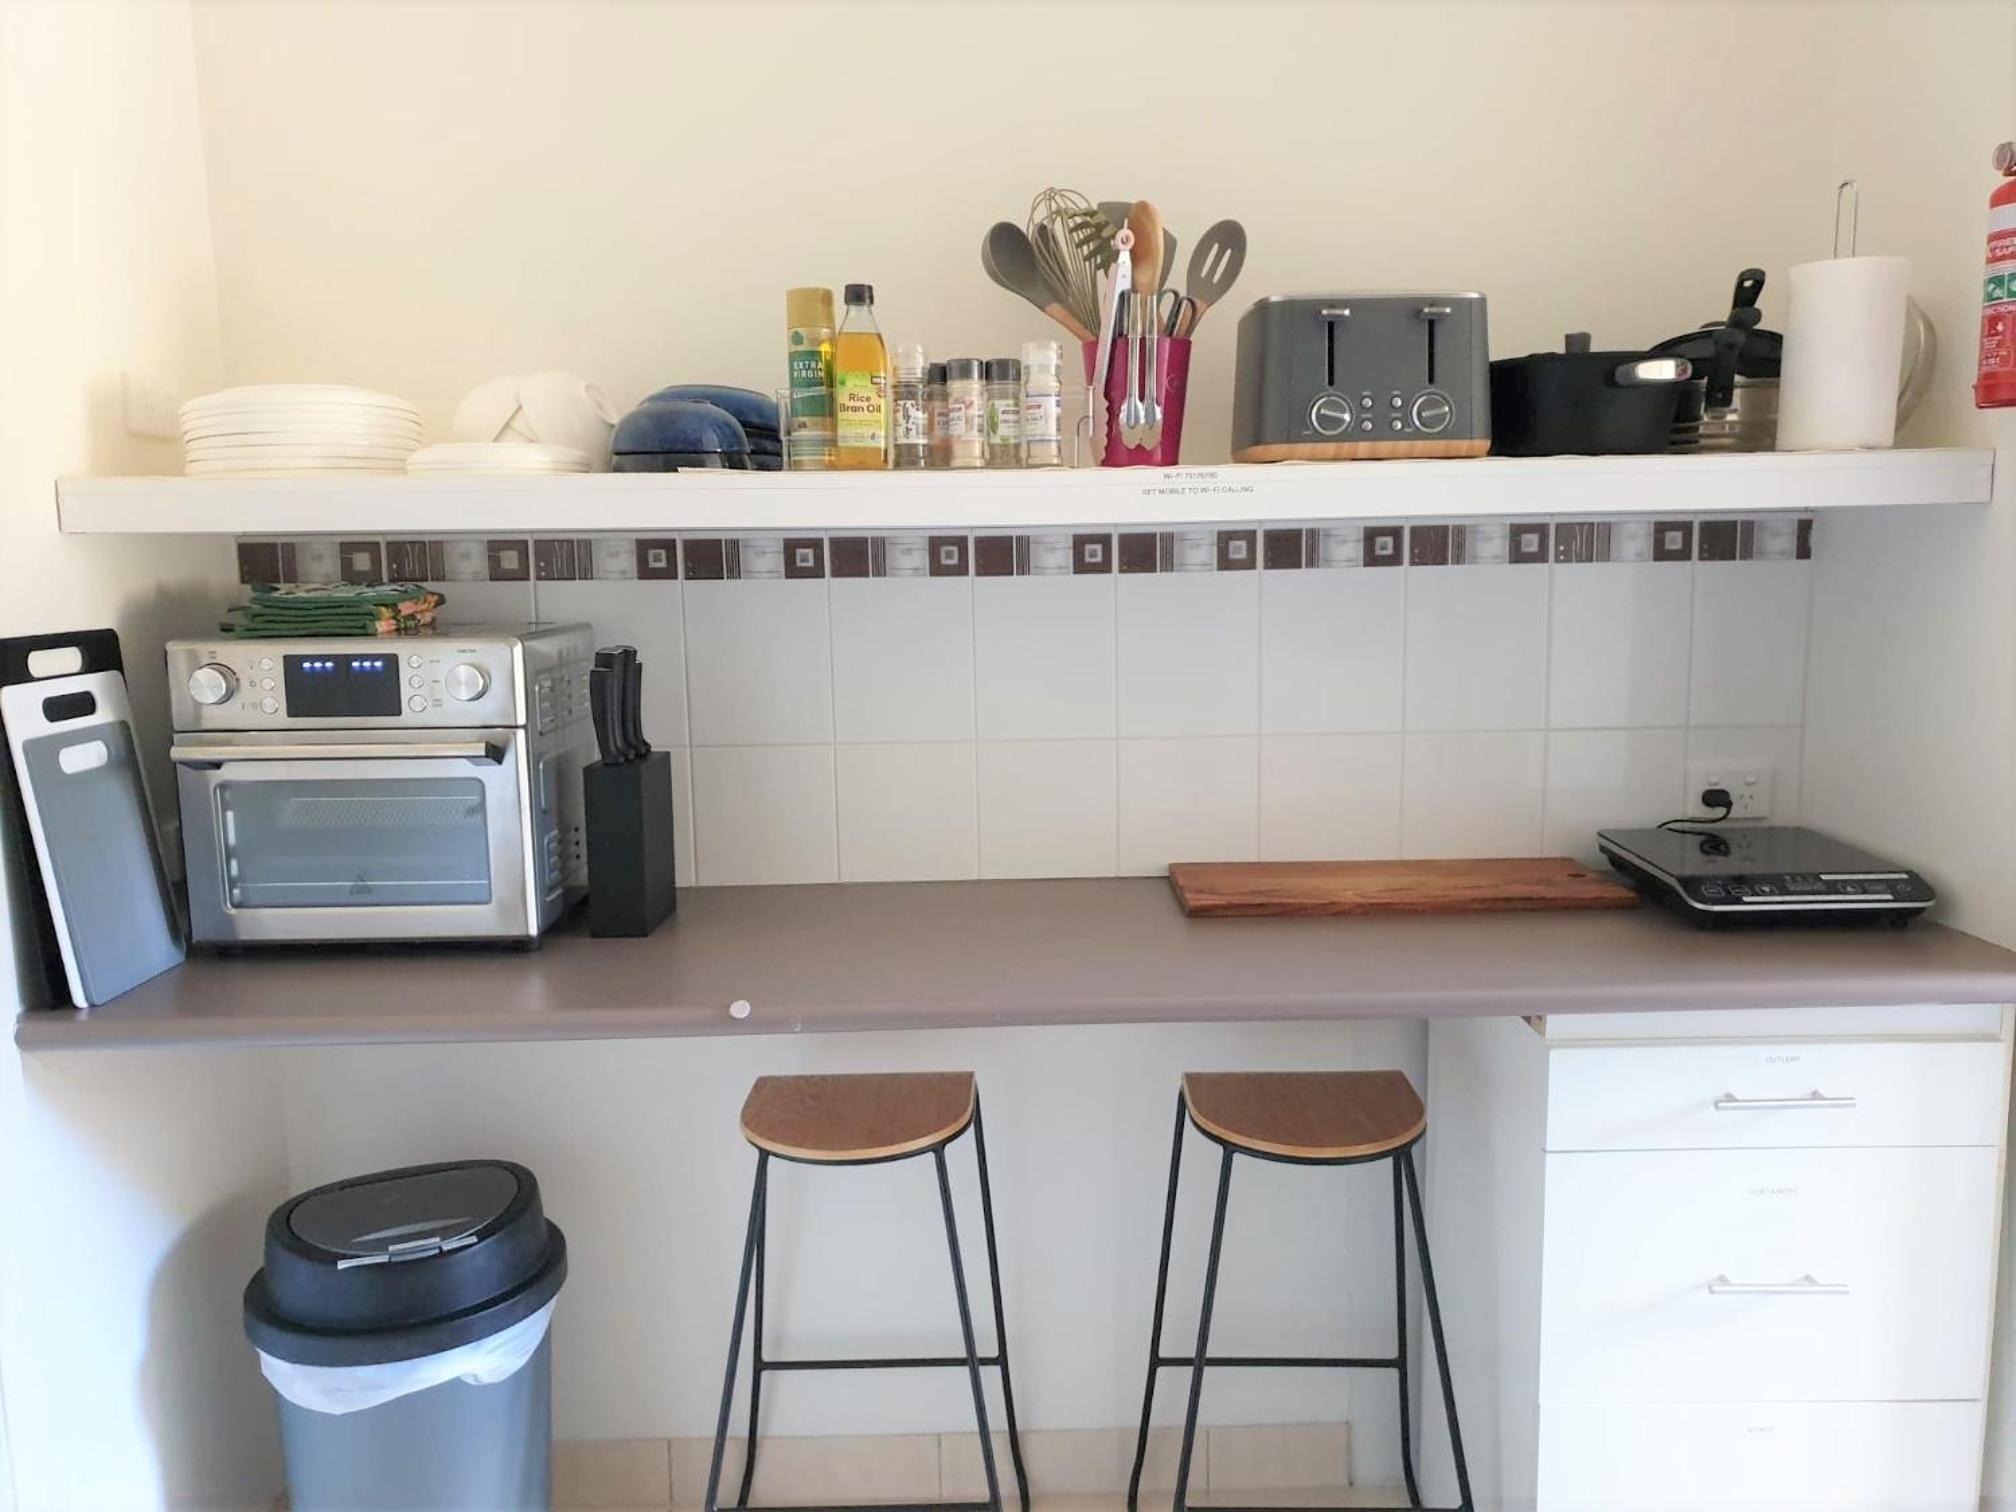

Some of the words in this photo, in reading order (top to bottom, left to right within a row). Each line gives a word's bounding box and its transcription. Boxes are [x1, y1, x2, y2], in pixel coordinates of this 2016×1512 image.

[793, 360, 823, 370] EXTRA
[792, 370, 825, 379] VIRGIN
[848, 393, 872, 403] Rice
[839, 403, 865, 413] Bran
[866, 403, 882, 414] Oil
